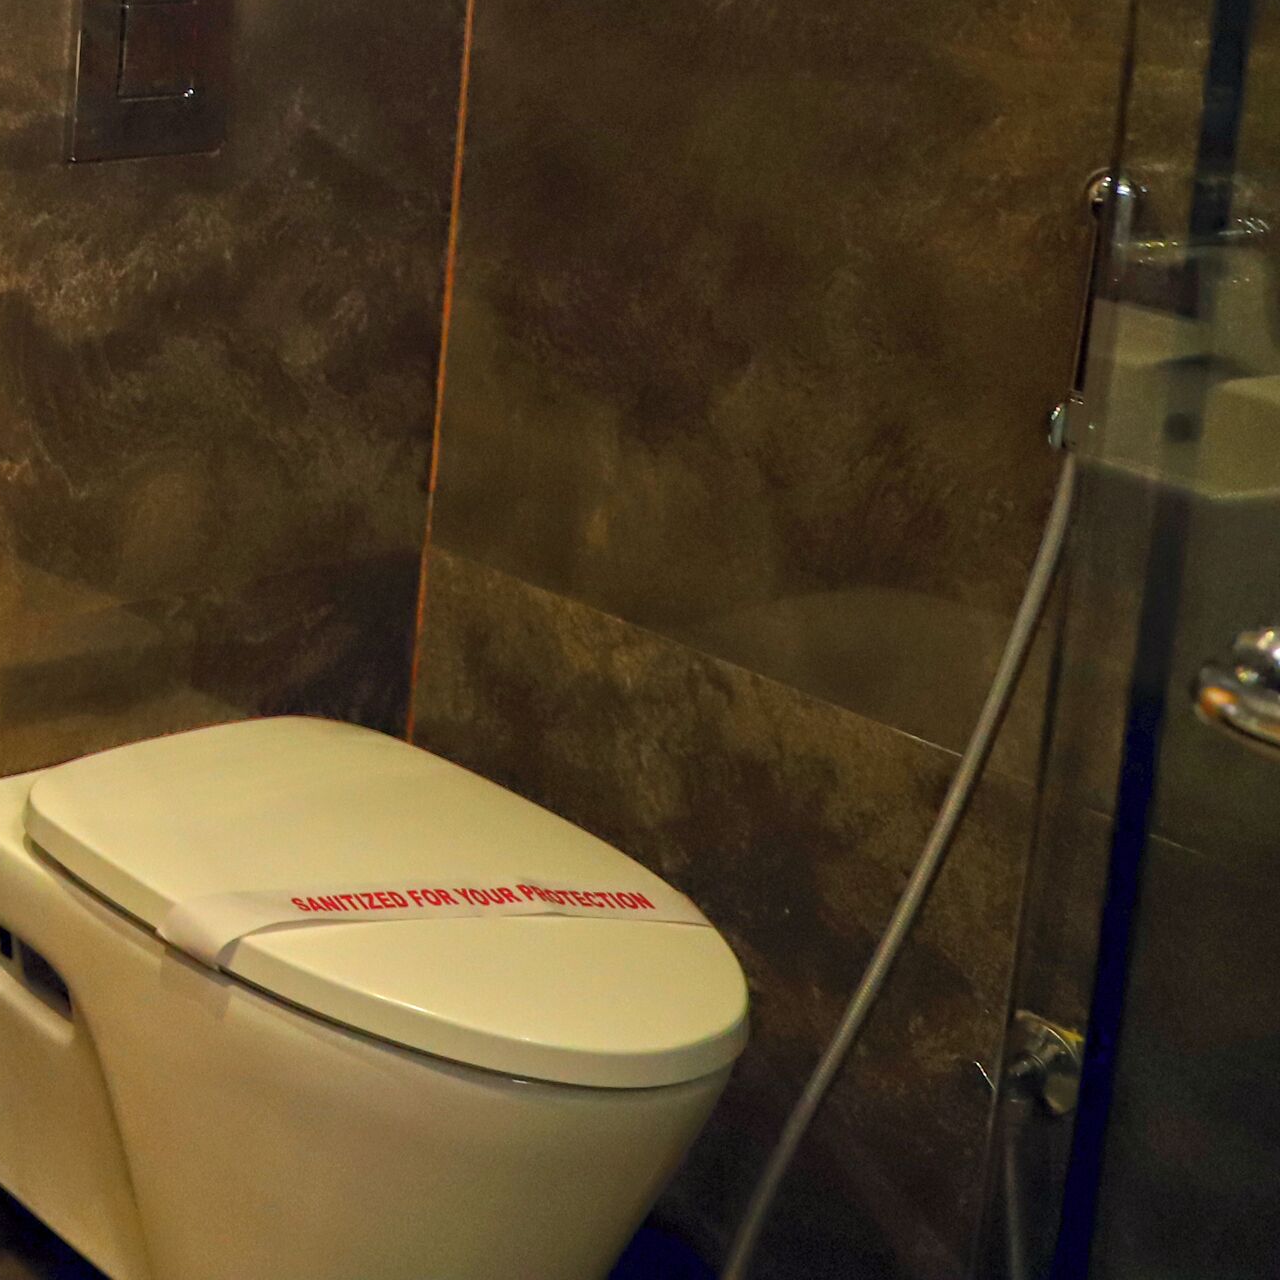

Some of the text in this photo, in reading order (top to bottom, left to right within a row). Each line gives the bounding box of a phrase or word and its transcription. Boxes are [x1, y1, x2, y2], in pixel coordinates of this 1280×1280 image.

[291, 883, 655, 913] SANITIZED FOR YOUR PROTECTION
